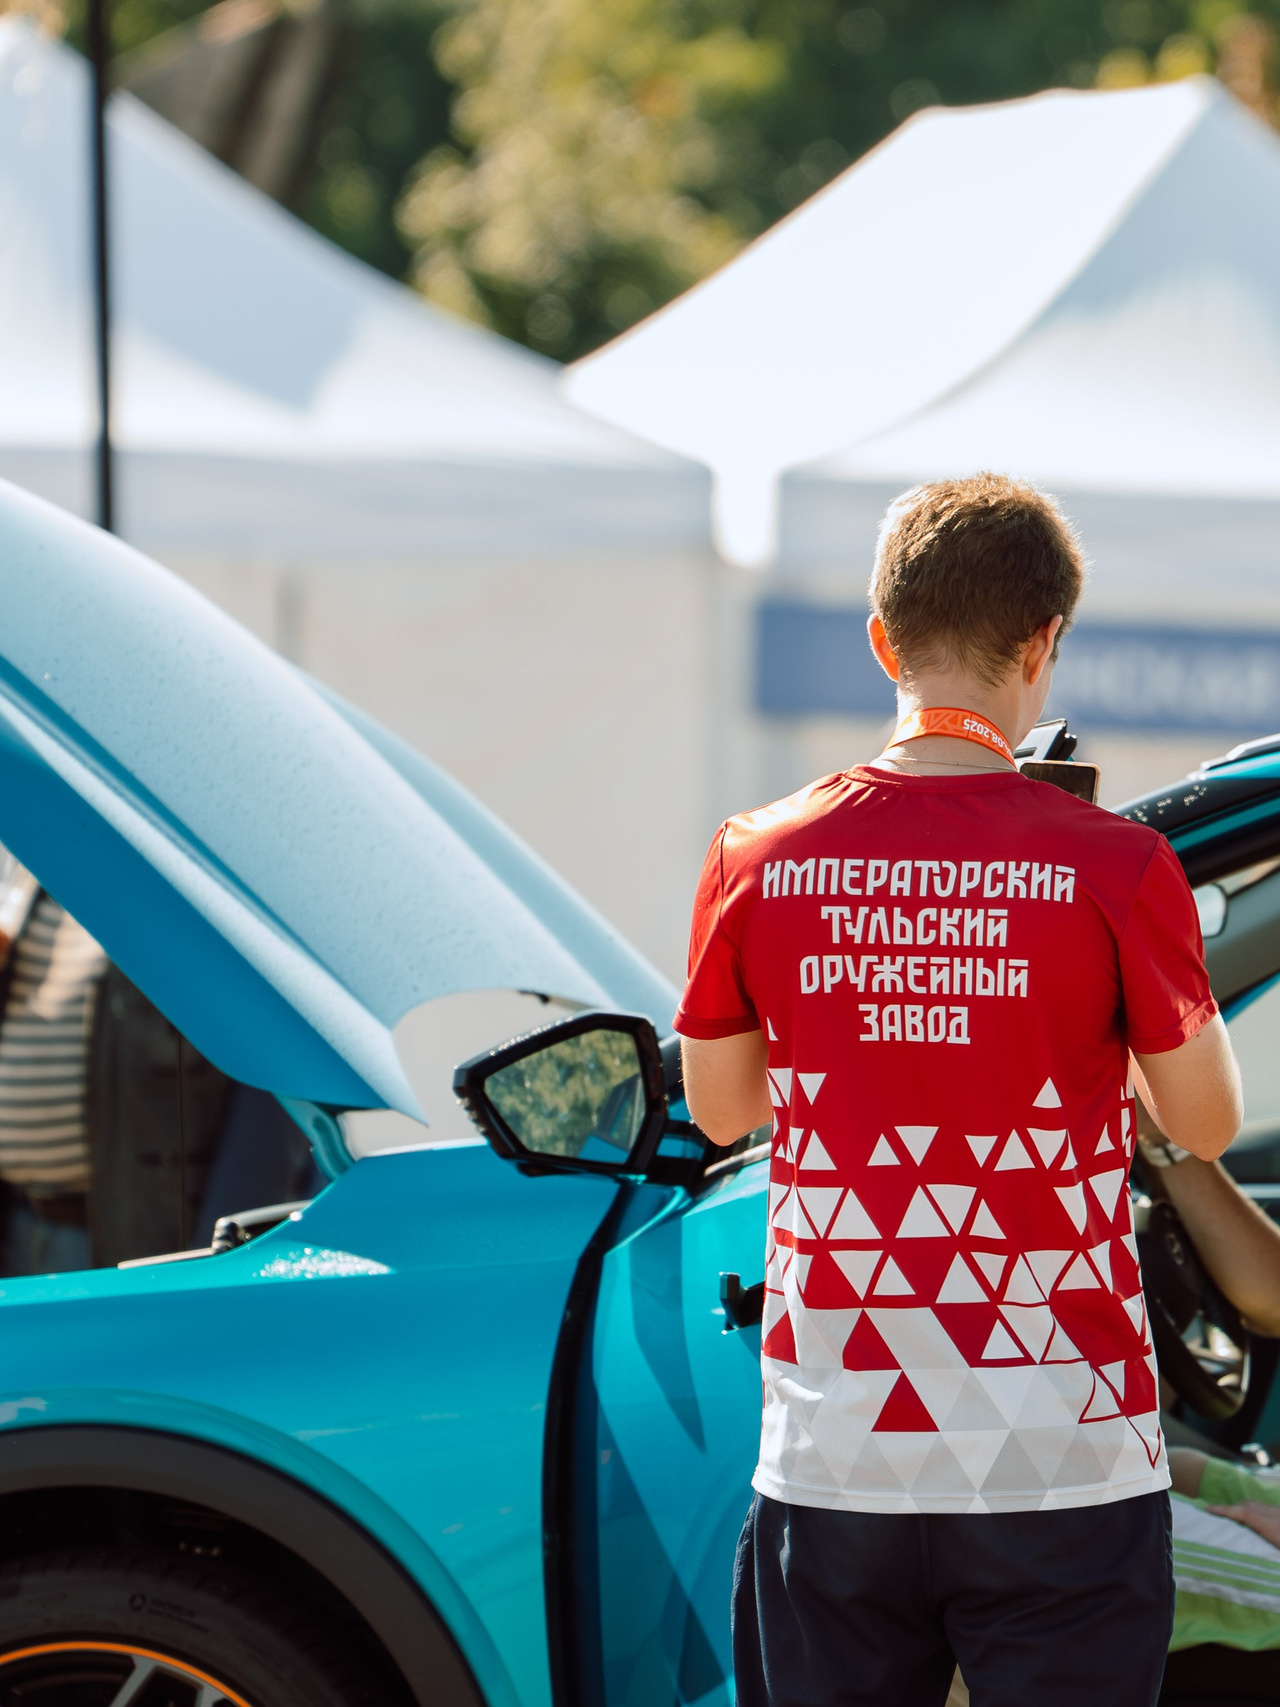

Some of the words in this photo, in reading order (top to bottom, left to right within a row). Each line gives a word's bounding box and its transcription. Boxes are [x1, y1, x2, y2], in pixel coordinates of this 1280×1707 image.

[762, 858, 1076, 903] ИМПЕРАТОРСКИЙ
[820, 906, 1009, 947] ТУЛЬСКИЙ
[799, 955, 1029, 998] ОРУЖЕЙНЫЙ
[858, 1003, 971, 1045] ЗАВОД
